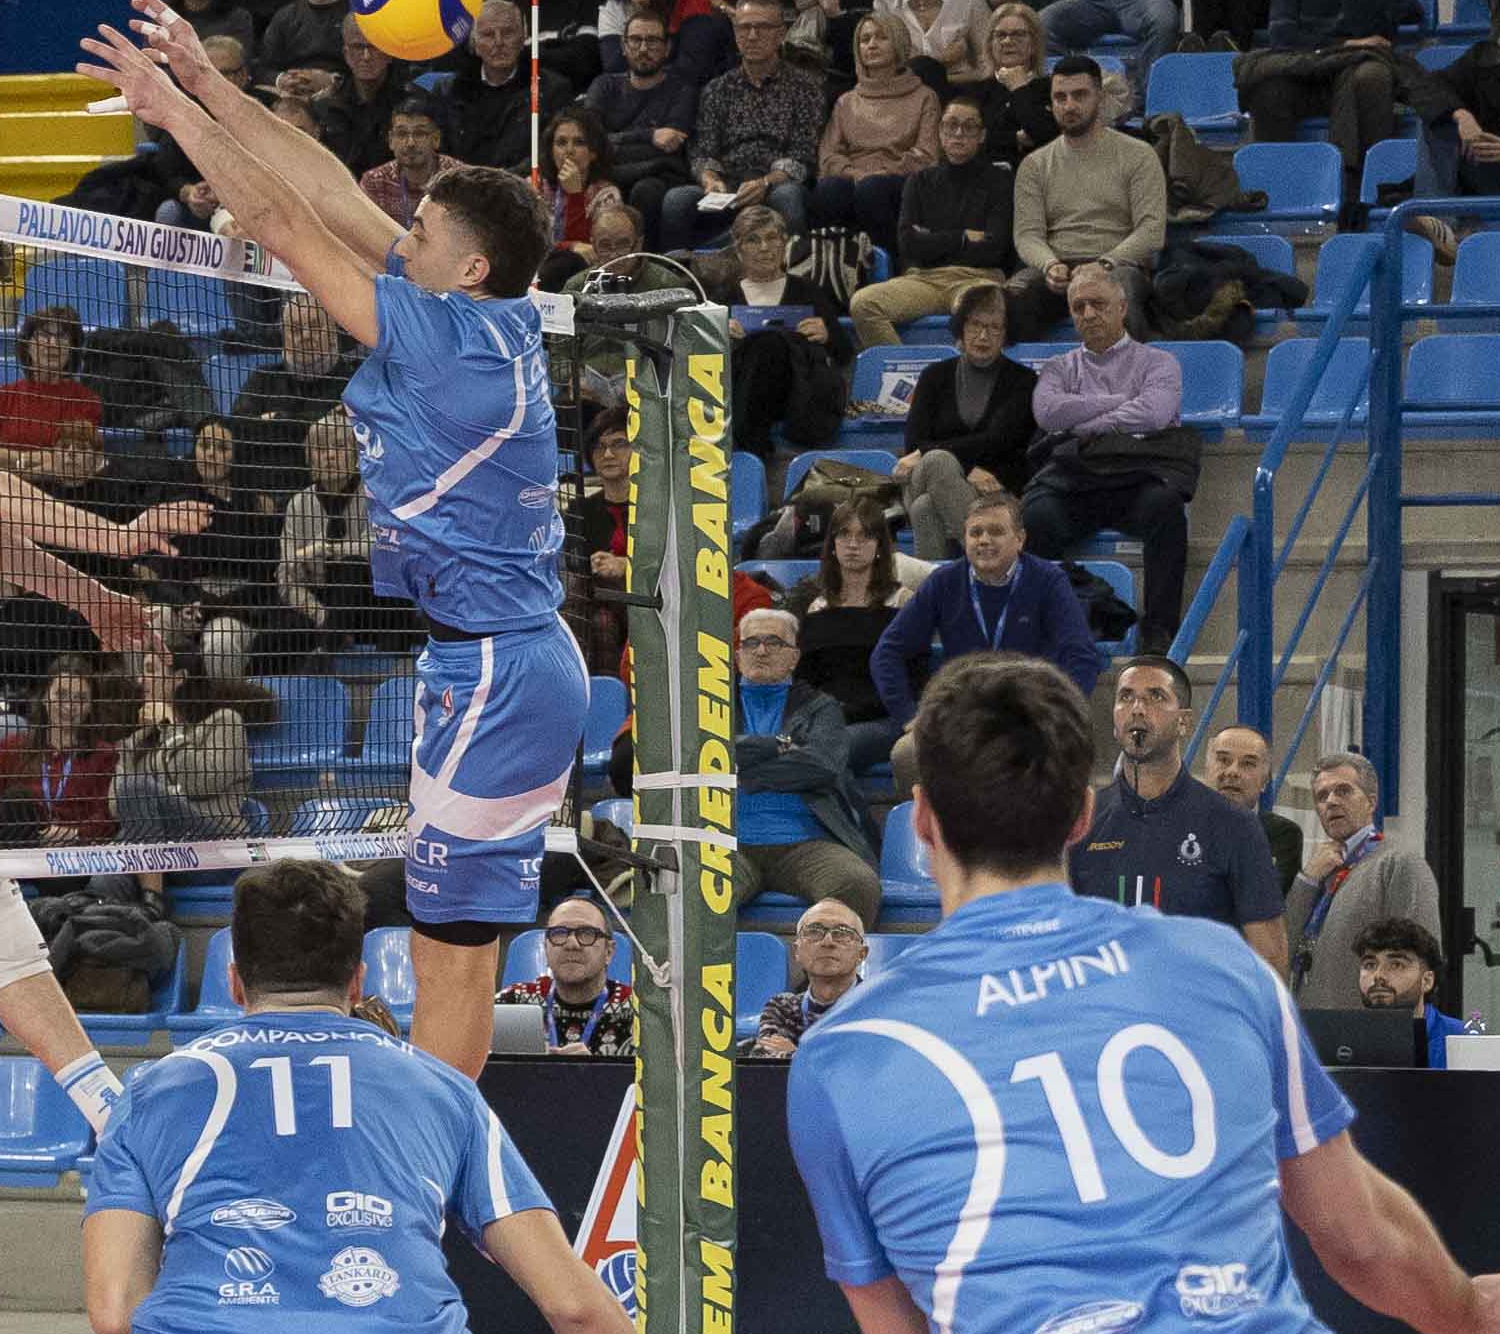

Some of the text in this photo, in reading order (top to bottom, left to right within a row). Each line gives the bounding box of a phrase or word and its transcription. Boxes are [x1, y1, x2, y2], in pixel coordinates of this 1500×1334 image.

[16, 201, 224, 270] PALLAVOLO SAN GIUSTINO
[686, 353, 733, 915] CREDEM BANCA
[46, 846, 200, 876] PALLAVOLO SAN GIUSTINO
[314, 834, 401, 860] PALLAVOLO SAN
[407, 836, 448, 867] CR
[406, 873, 440, 896] EGEA
[975, 939, 1130, 1017] ALPINI
[249, 1055, 353, 1136] 11
[700, 963, 734, 1209] BANCA
[1009, 1022, 1217, 1204] 10
[325, 1191, 393, 1214] GIO
[325, 1210, 393, 1228] exclusive
[326, 1267, 393, 1285] TANKARD
[217, 1296, 280, 1305] AMBIENTE
